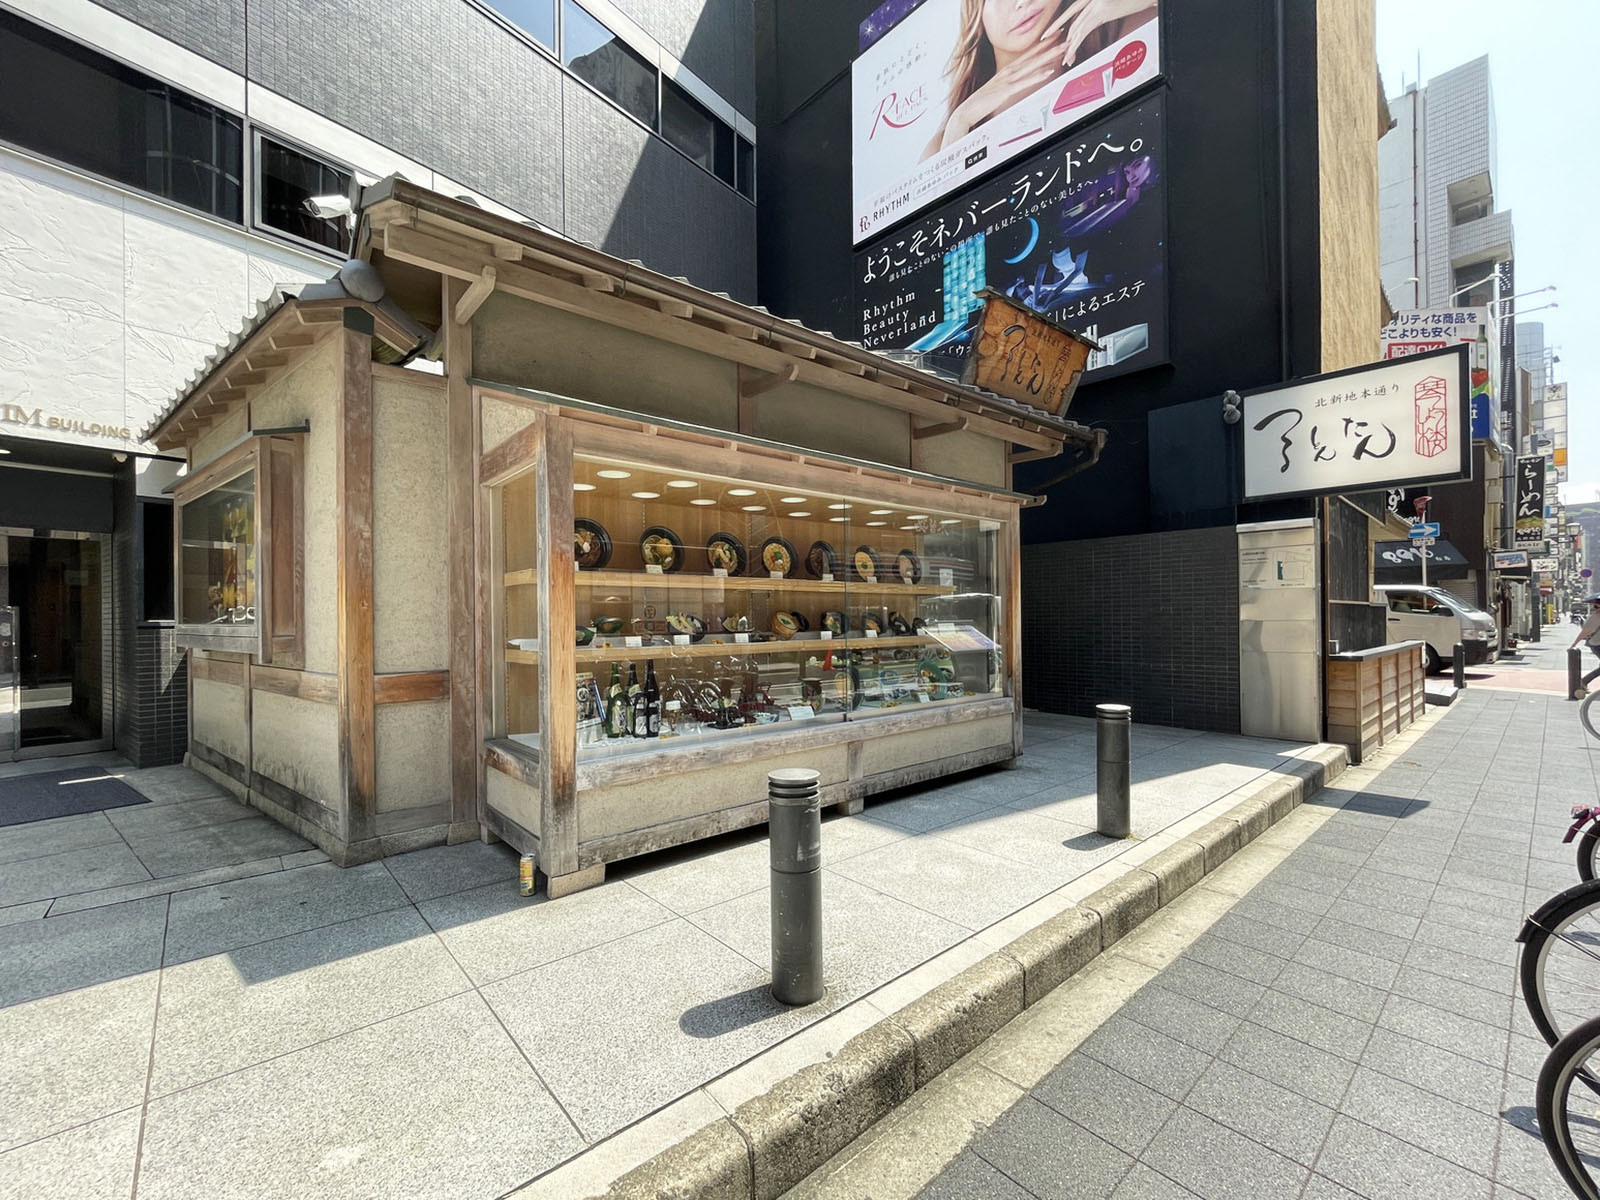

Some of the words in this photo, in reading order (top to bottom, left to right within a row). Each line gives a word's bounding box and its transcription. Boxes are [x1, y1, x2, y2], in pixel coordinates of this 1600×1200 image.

[863, 138, 1143, 283] ようこそネバーランドへ。
[873, 192, 910, 221] RHYTHM
[863, 291, 916, 321] Rhythm
[863, 309, 909, 335] Beauty
[863, 310, 936, 350] Neverland
[1315, 384, 1399, 408] 北新地本通り
[48, 416, 131, 440] BUILDING
[1519, 464, 1541, 517] らーめん
